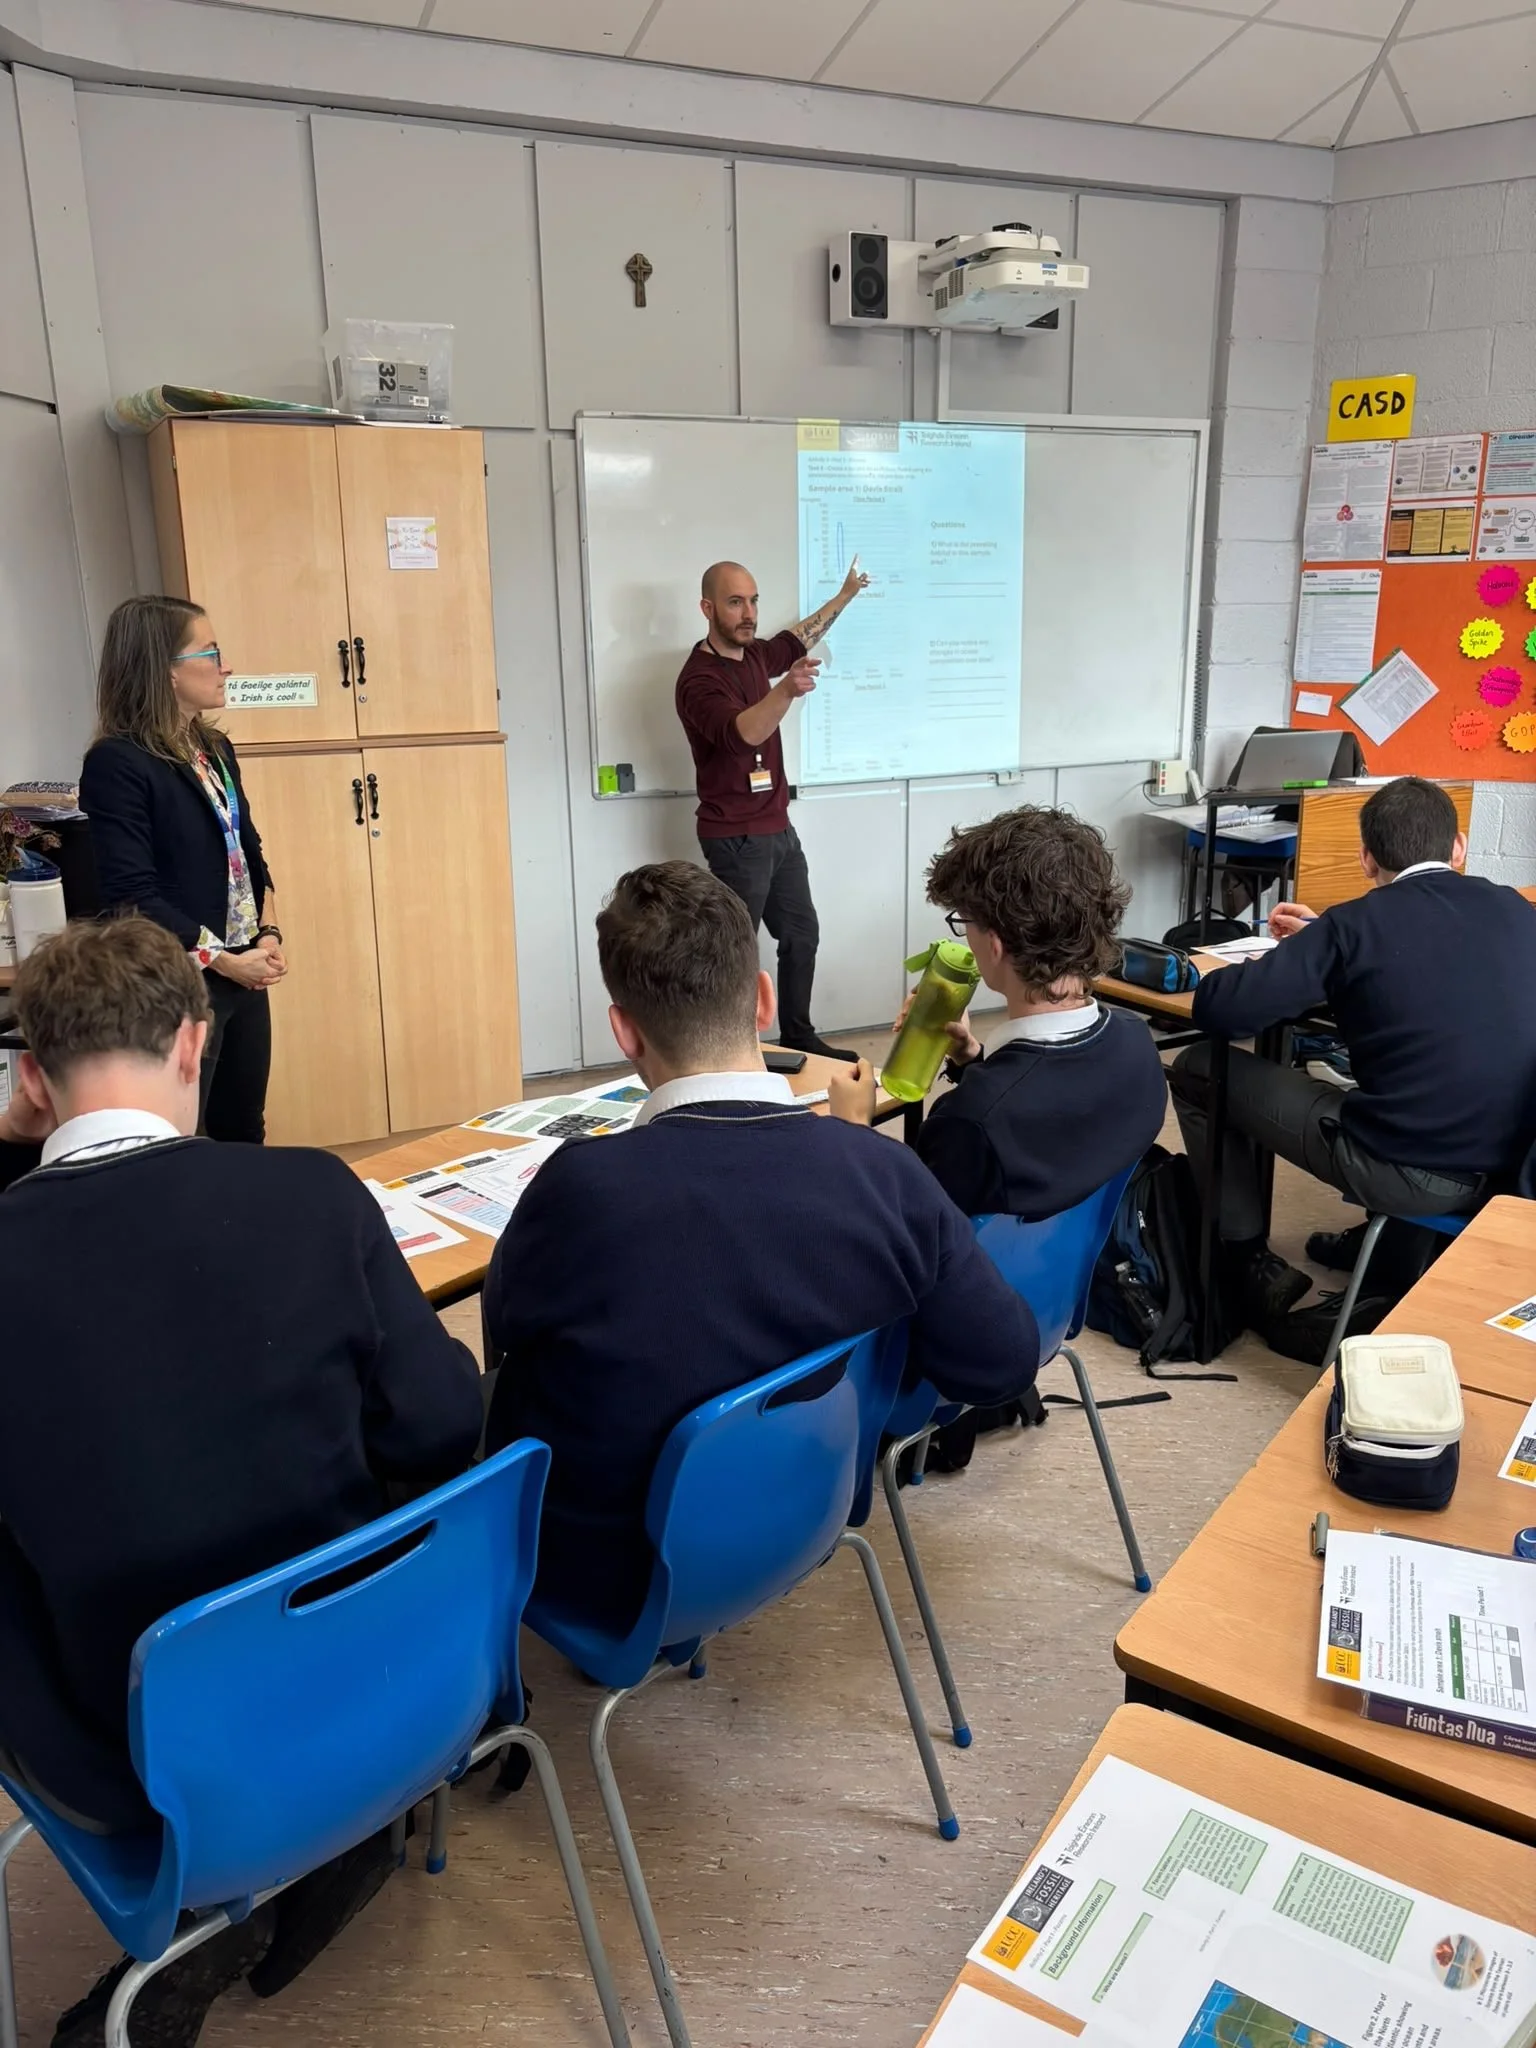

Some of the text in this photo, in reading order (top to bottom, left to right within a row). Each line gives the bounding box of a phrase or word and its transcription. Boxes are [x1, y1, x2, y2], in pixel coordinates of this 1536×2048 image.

[378, 362, 397, 392] 32
[1338, 390, 1406, 419] CASD
[1468, 628, 1494, 638] Golden
[1468, 638, 1488, 650] Spike
[240, 680, 273, 692] Gaeilge
[240, 692, 297, 702] Irish is cool!
[1477, 1590, 1486, 1604] Period
[1341, 1610, 1352, 1632] FOSSIL
[1405, 1706, 1497, 1746] Fiúntas Nua
[1066, 1833, 1084, 1854] Taighde
[1074, 1813, 1106, 1858] Research Ireland
[1025, 1866, 1048, 1897] IRELAND'S
[1035, 1872, 1061, 1904] FOSSIL
[1048, 1878, 1072, 1909] HERITAGE
[1002, 1927, 1021, 1948] UCC
[1048, 1893, 1104, 1974] Background Information
[1361, 2021, 1376, 2041] Figure
[1373, 2001, 1386, 2015] Map
[1380, 1992, 1387, 2001] of
[1396, 2001, 1413, 2028] showing
[1374, 2017, 1391, 2047] the North
[1402, 2026, 1415, 2047] ocean
[1420, 2023, 1429, 2037] and
